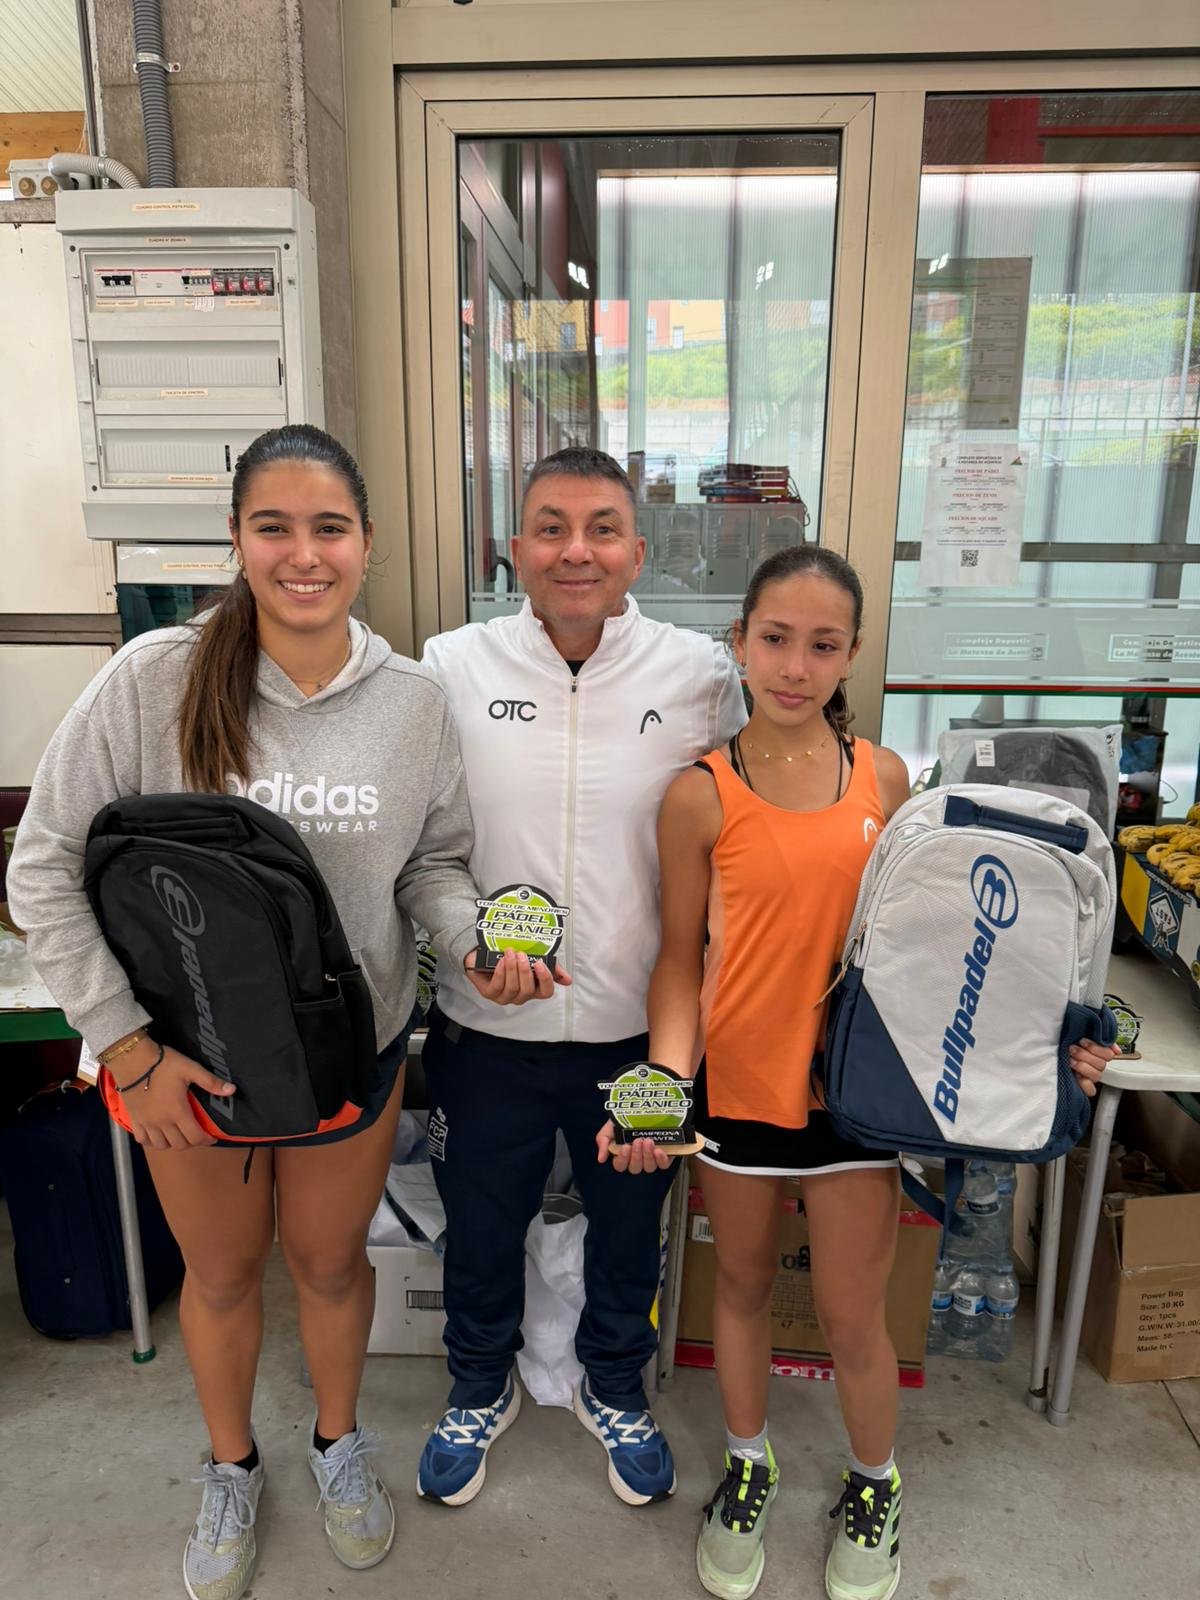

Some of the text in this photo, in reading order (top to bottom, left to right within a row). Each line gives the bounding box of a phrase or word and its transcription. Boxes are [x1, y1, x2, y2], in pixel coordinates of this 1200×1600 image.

[488, 699, 537, 722] OTC
[224, 772, 380, 816] adidas
[478, 900, 513, 909] TORNEO
[527, 905, 569, 915] MENORES
[933, 916, 996, 1124] Bullpadel
[1137, 1345, 1158, 1353] Made
